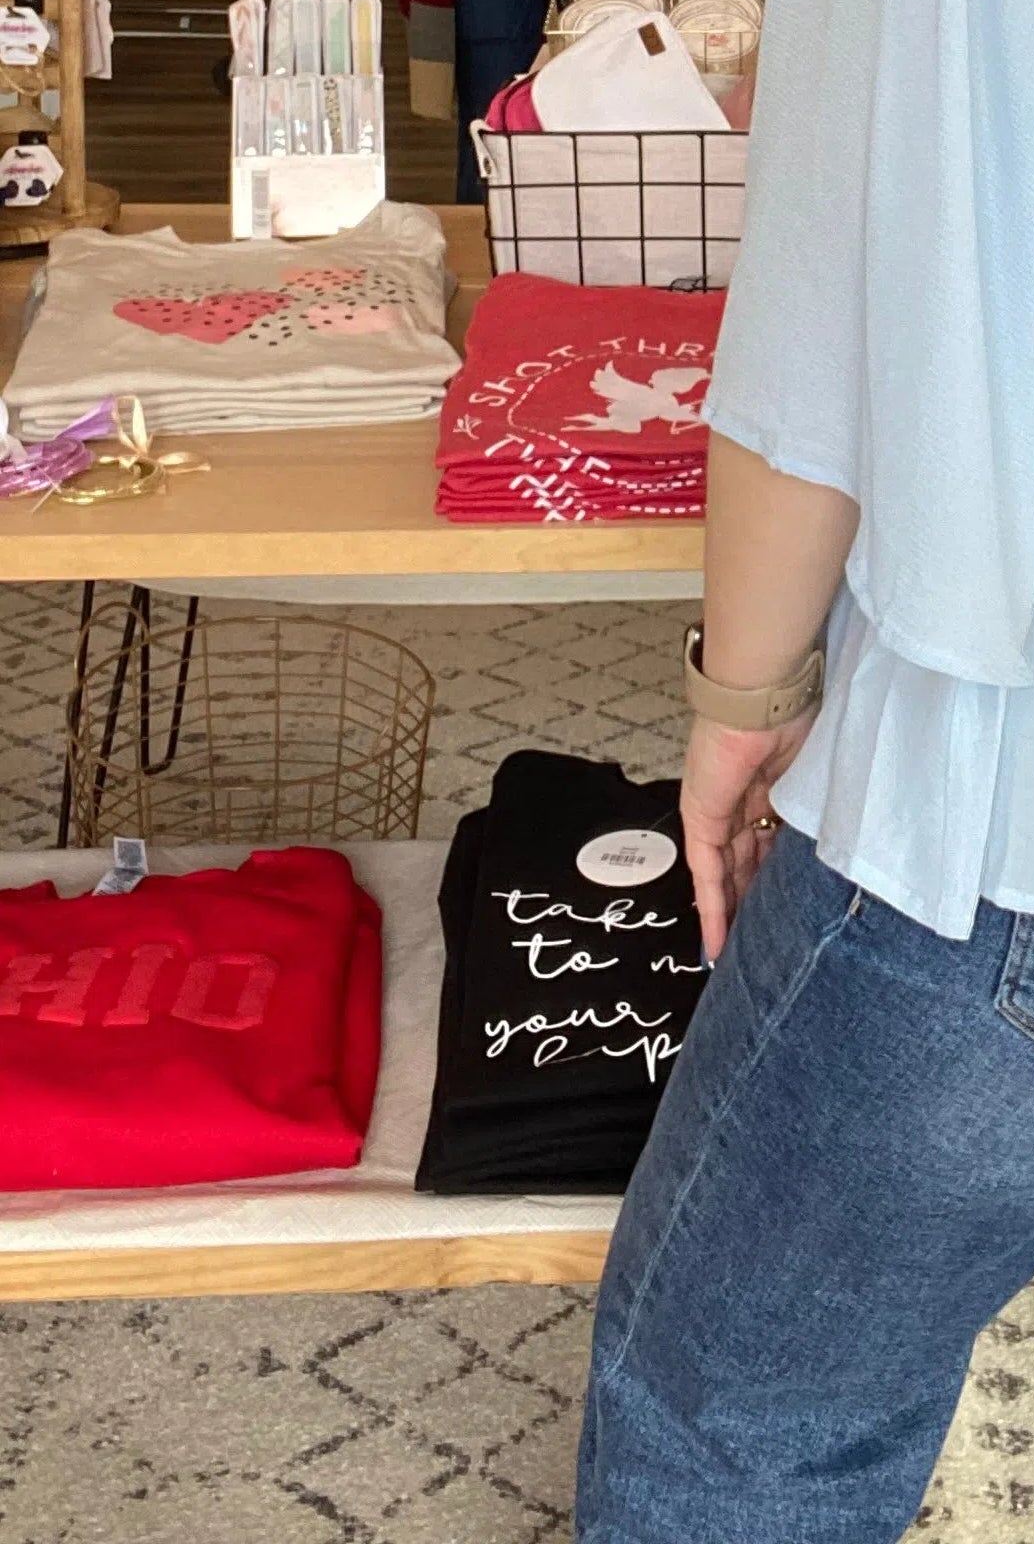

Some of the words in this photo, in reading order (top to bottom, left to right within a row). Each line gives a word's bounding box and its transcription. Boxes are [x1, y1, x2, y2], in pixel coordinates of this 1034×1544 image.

[468, 344, 576, 407] SHOT
[599, 336, 714, 358] THR
[490, 889, 678, 933] take
[511, 933, 619, 979] to
[0, 943, 280, 1031] HIO
[484, 1001, 673, 1058] your
